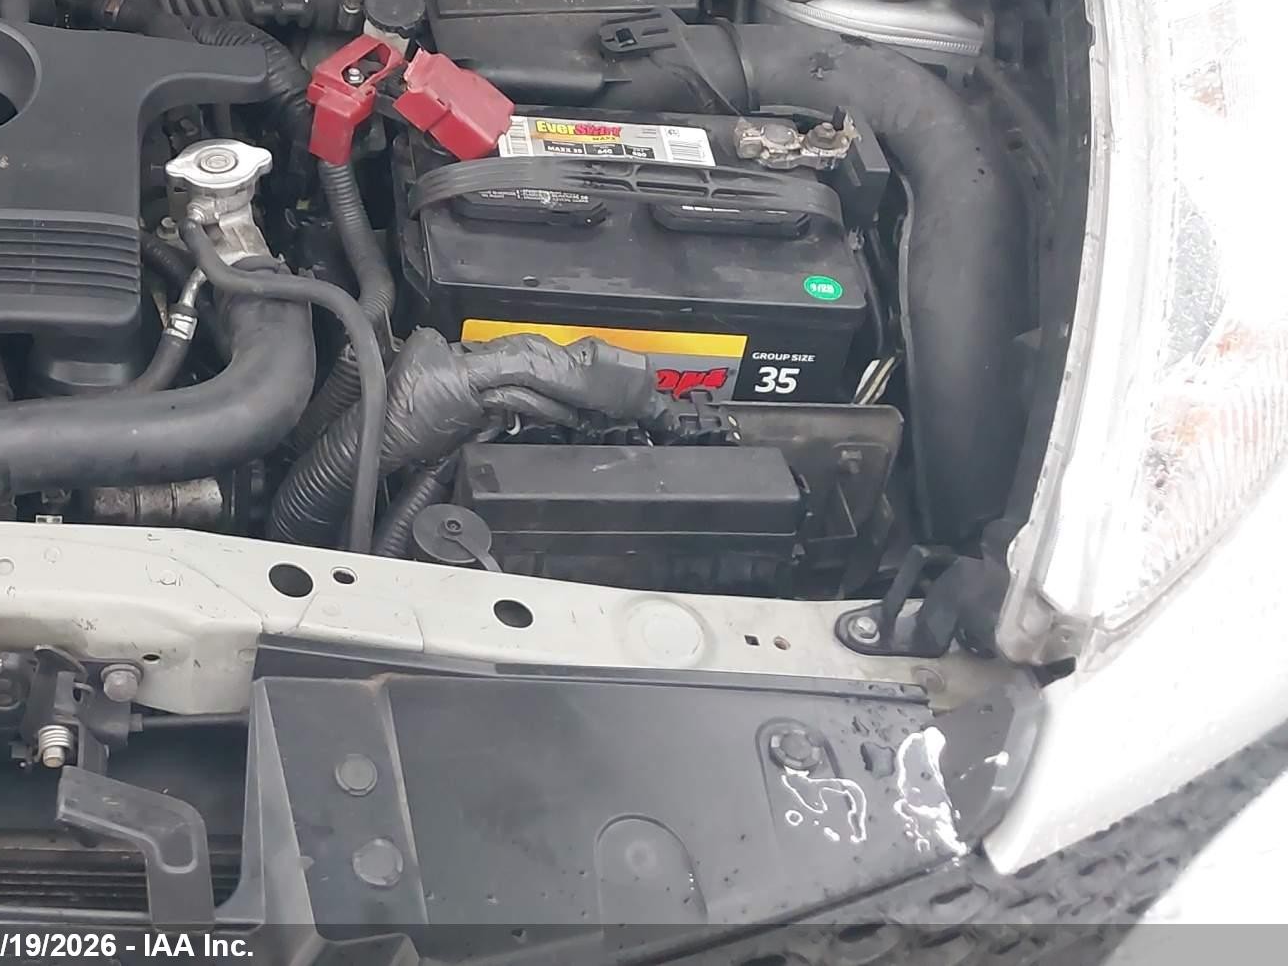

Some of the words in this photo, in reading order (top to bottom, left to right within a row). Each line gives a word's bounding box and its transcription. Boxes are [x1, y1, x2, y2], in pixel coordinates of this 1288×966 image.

[535, 119, 622, 138] EverStart
[752, 352, 791, 362] GROUP
[791, 353, 816, 363] SIZE
[754, 366, 800, 394] 35
